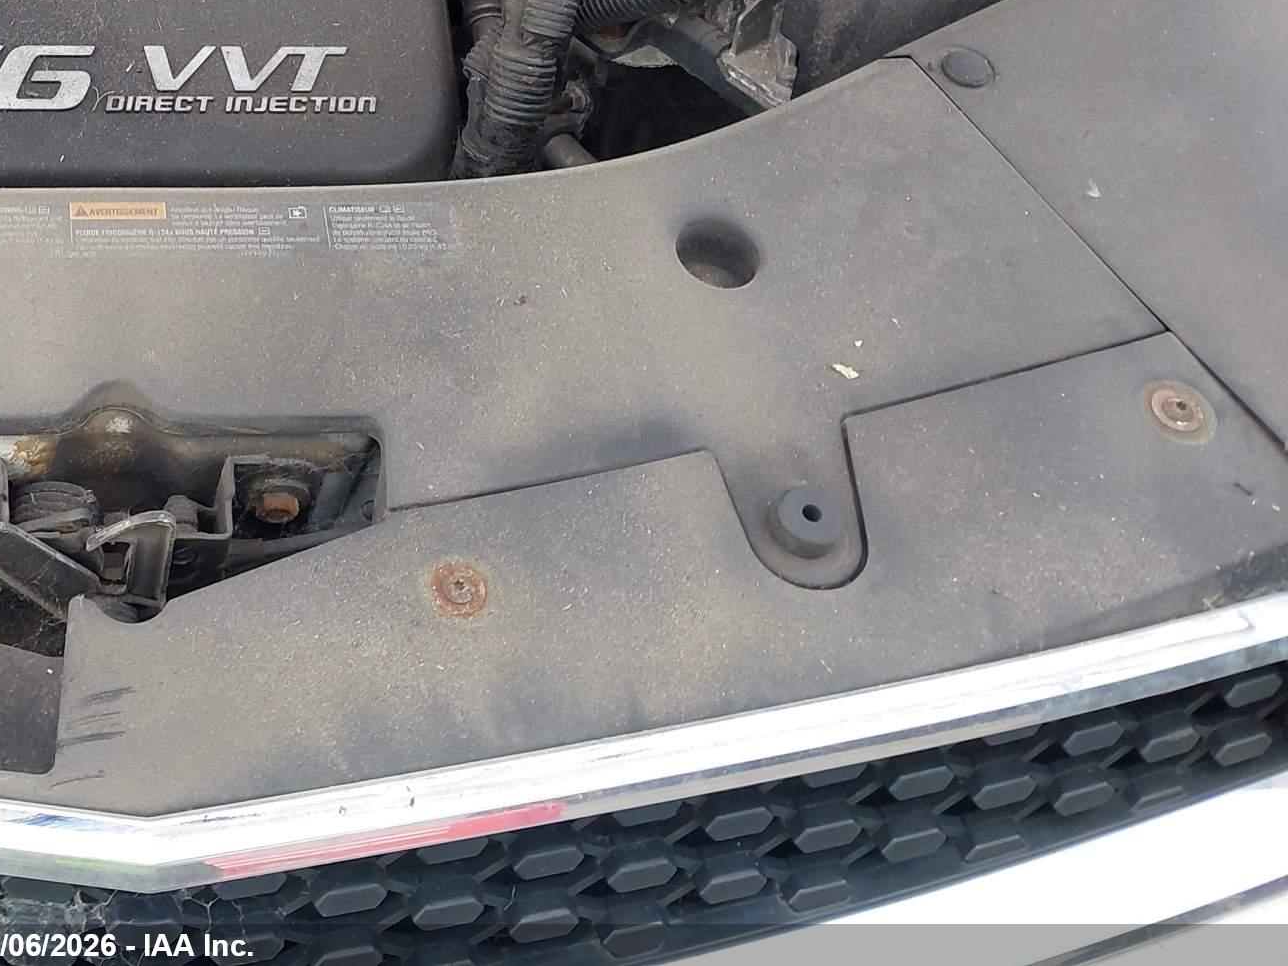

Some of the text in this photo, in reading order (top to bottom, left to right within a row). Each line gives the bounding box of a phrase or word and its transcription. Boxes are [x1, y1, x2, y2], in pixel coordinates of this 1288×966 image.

[143, 45, 349, 93] VVT
[106, 96, 377, 113] DIRECT INJECTION
[89, 207, 159, 217] AVERTISSEMENT
